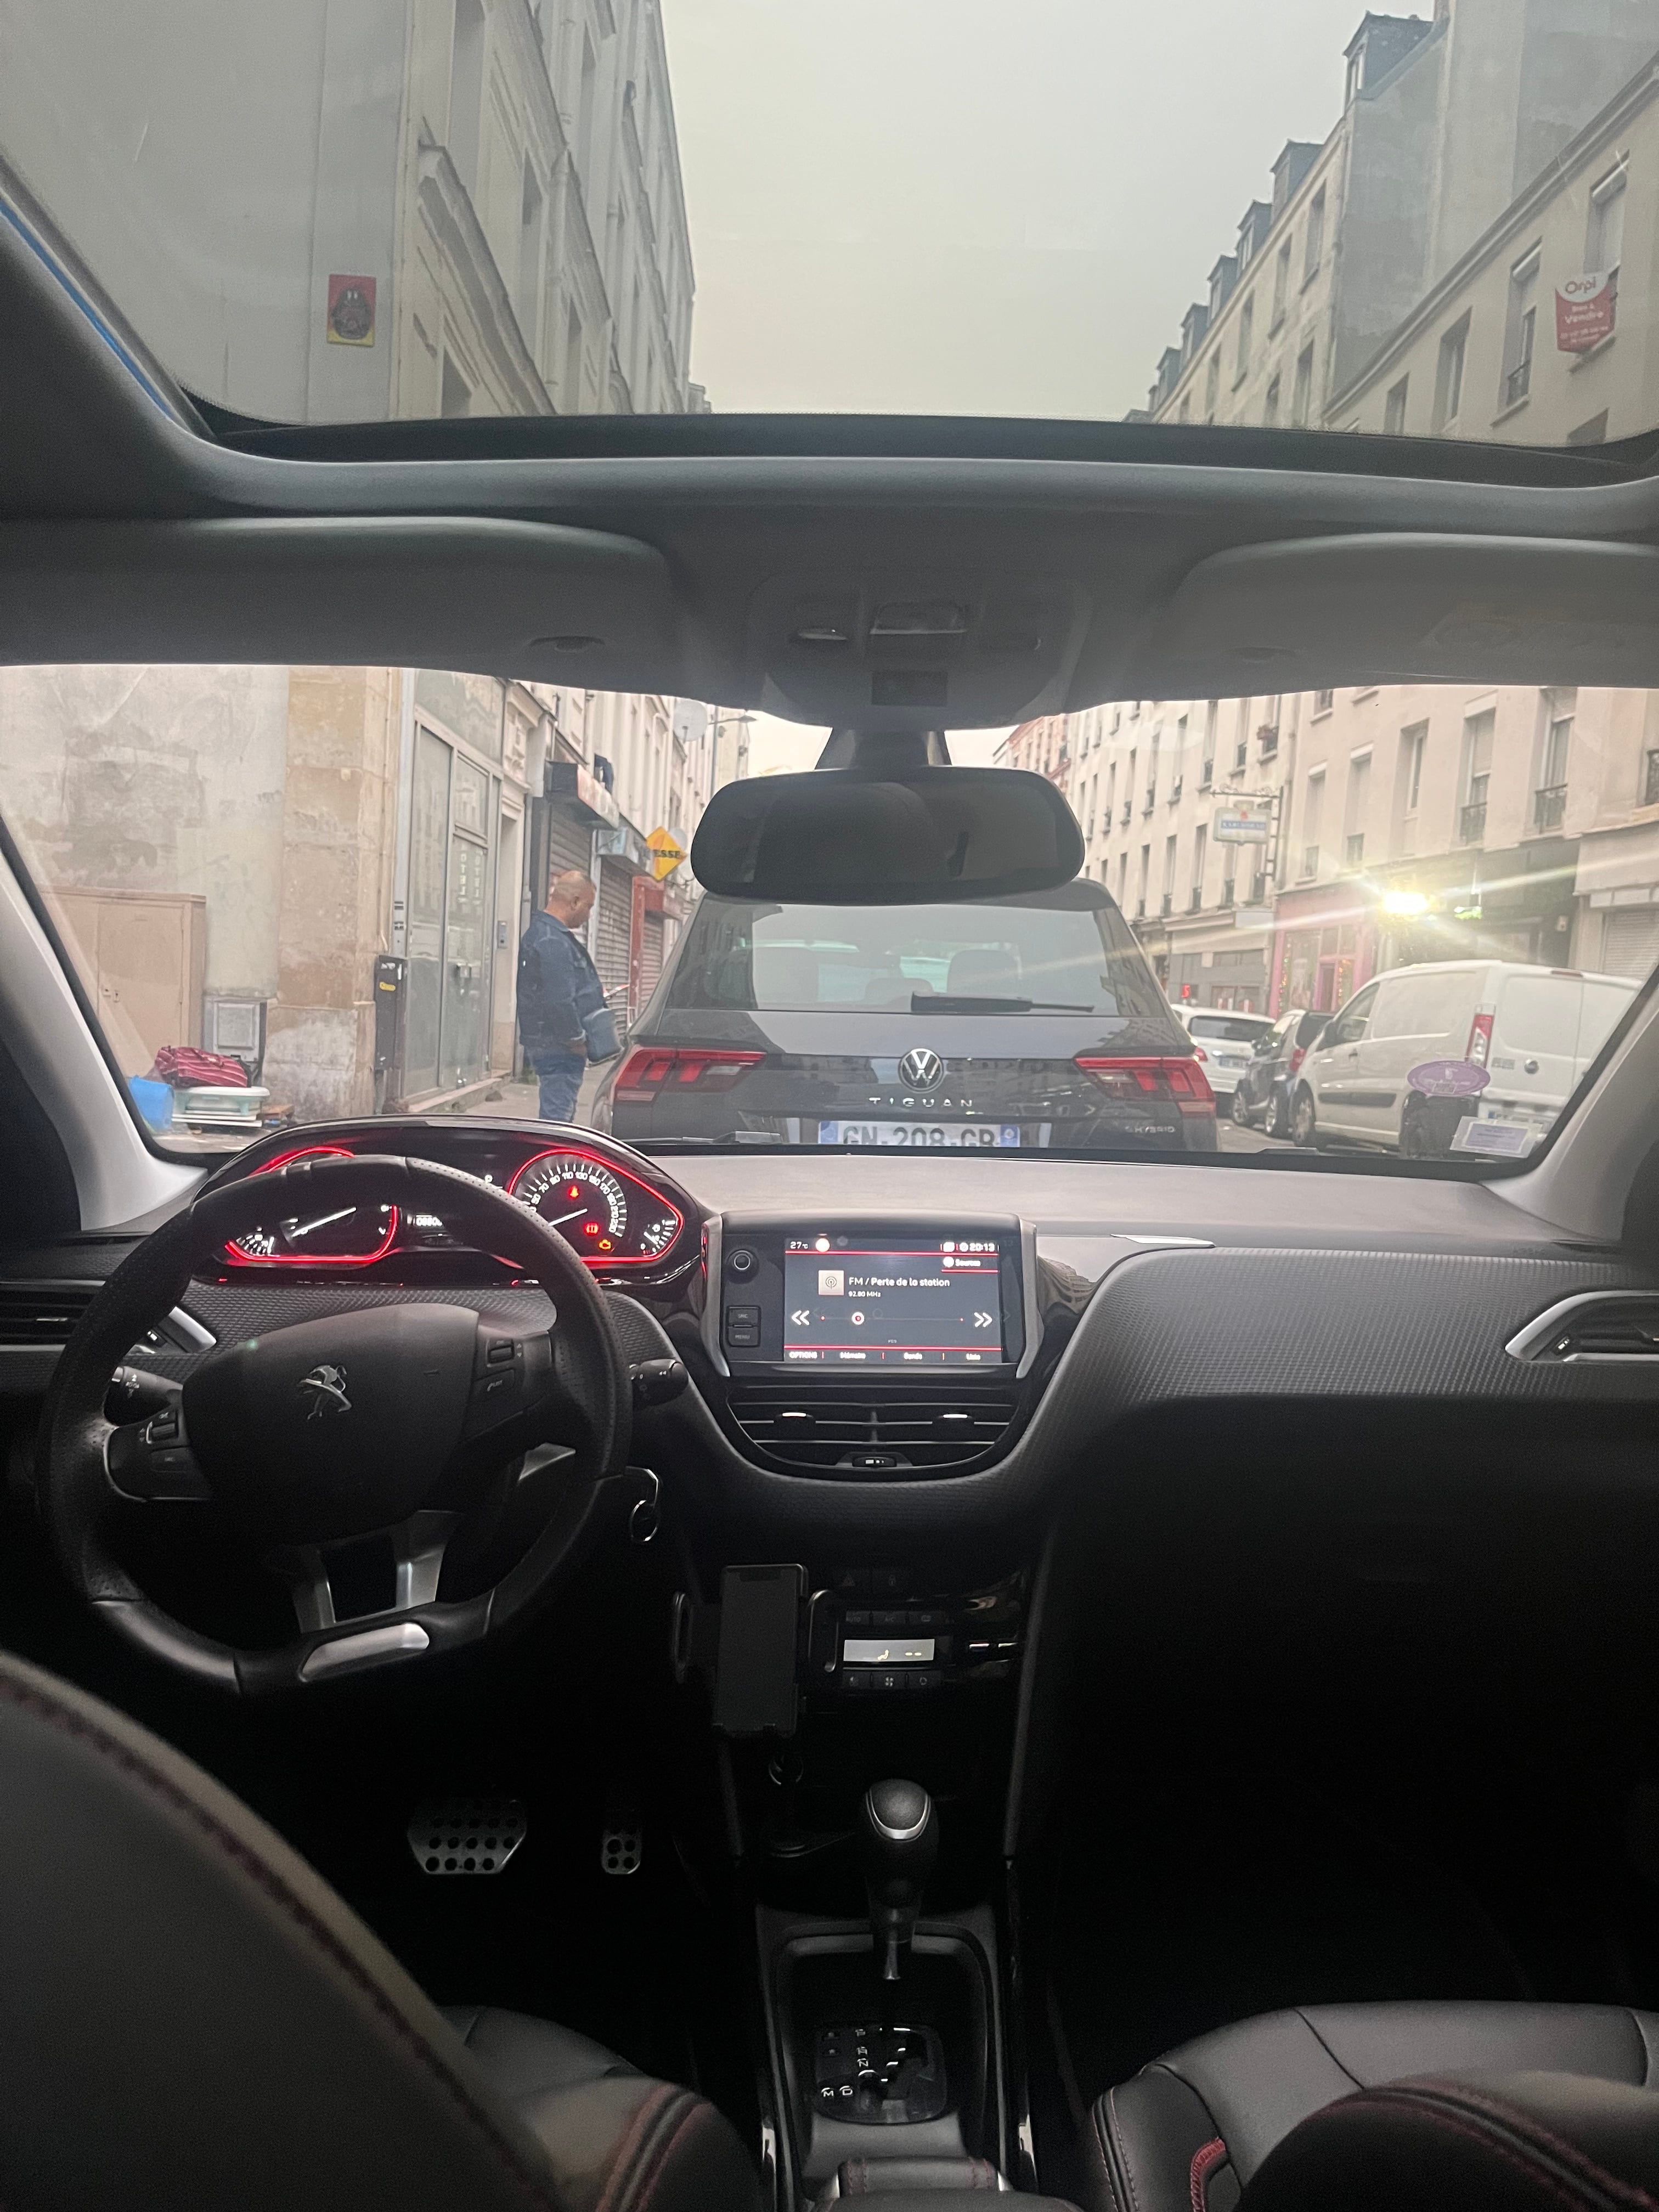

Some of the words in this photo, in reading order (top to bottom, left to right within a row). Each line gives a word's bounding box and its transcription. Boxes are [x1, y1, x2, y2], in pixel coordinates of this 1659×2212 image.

[1565, 276, 1596, 295] Orpi
[868, 1097, 973, 1107] TIGUAN
[562, 1171, 574, 1180] 110
[575, 1171, 589, 1181] 130
[538, 1182, 550, 1194] 70
[600, 1182, 611, 1195] 170
[849, 1277, 863, 1285] FM
[871, 1277, 895, 1286] Perte
[896, 1277, 907, 1286] de
[909, 1277, 918, 1286] la
[919, 1278, 950, 1287] station
[789, 1351, 818, 1359] OPTIONS
